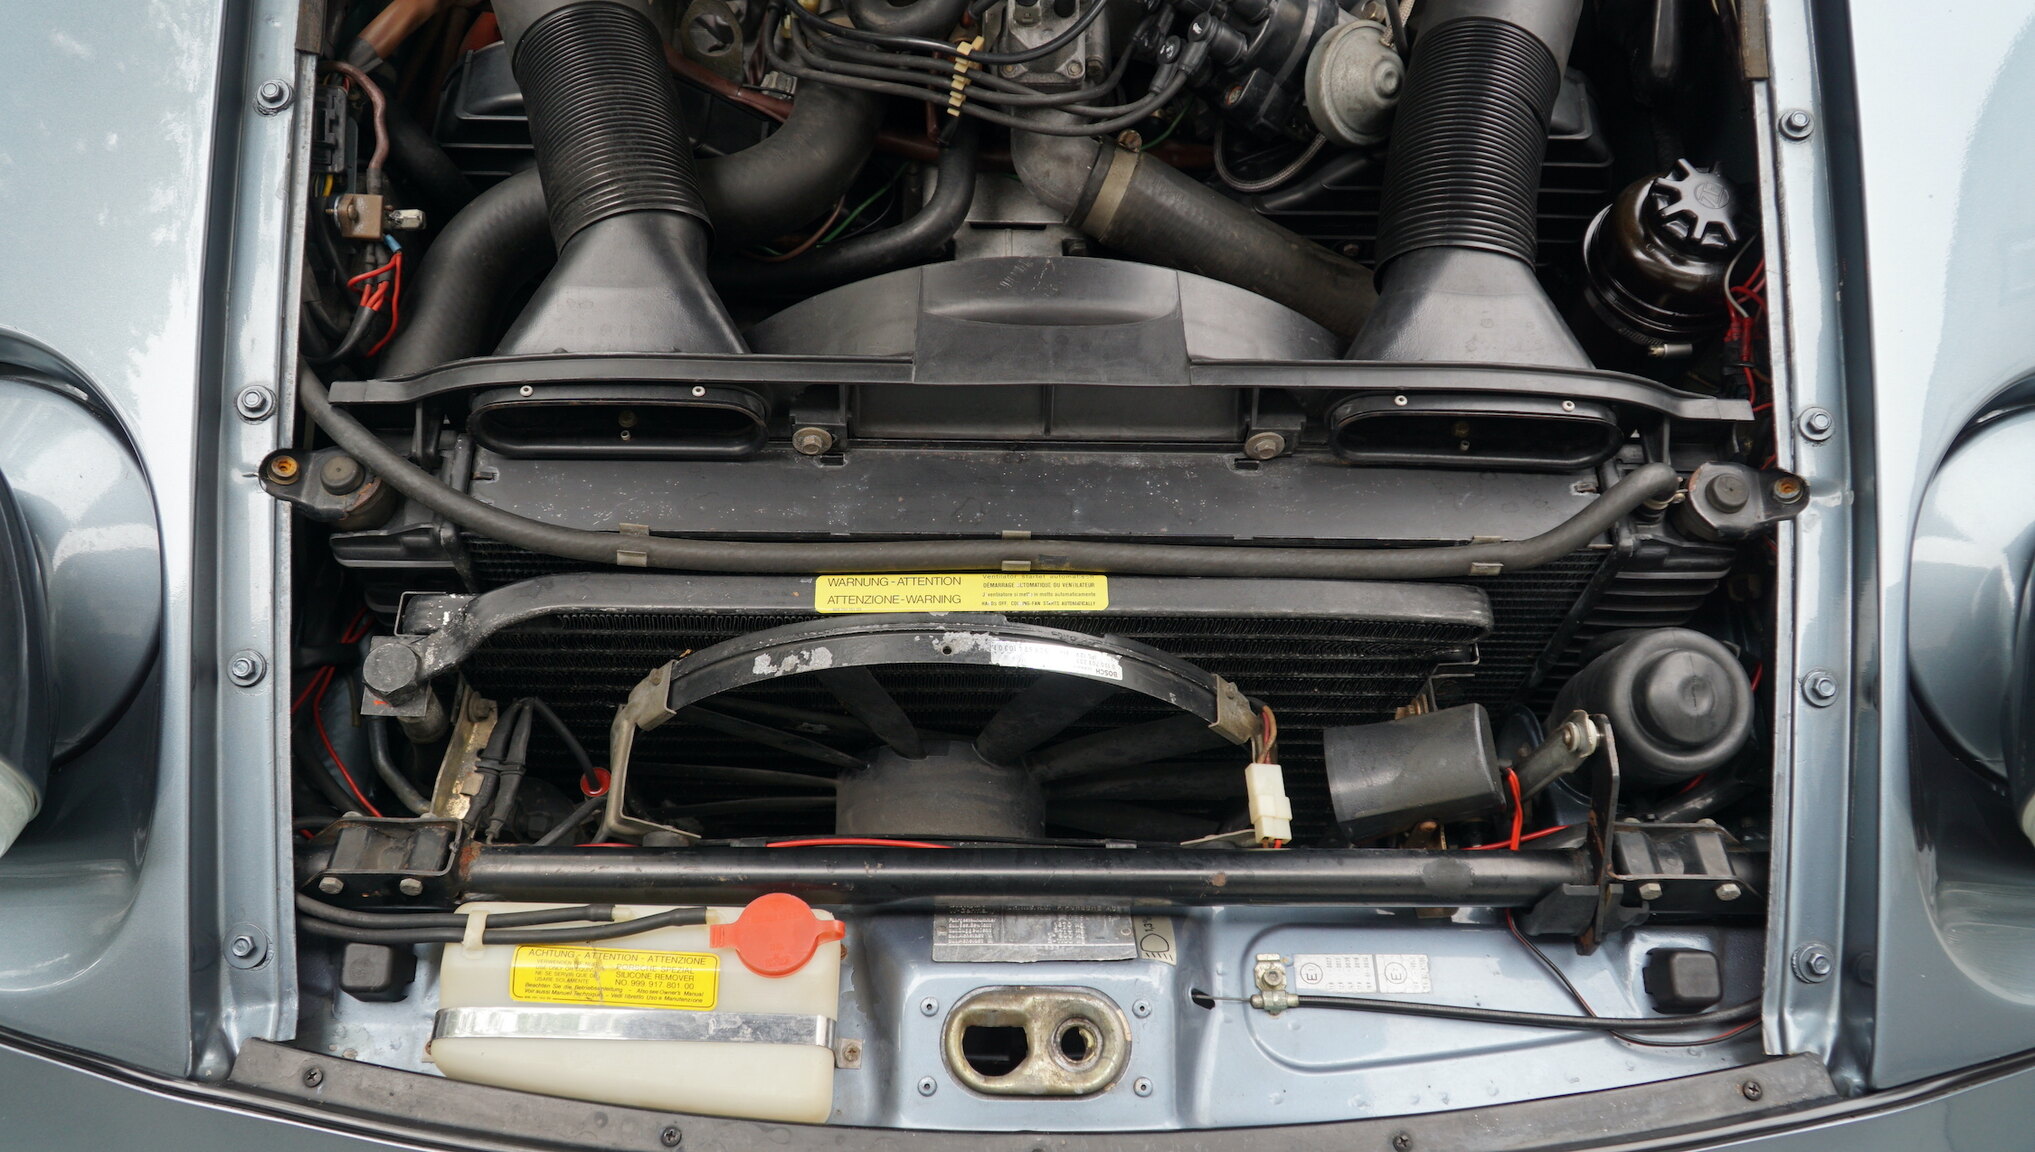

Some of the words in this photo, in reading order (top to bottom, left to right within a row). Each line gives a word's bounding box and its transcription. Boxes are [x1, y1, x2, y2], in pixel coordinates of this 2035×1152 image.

[827, 577, 888, 587] WARNUNG
[897, 576, 962, 586] ATTENTION
[1095, 668, 1118, 678] BOSCH
[528, 948, 575, 958] ACHTUNG
[584, 952, 639, 962] ATTENTION
[647, 955, 706, 965] ATTENZIONE
[616, 963, 656, 972] PORSCHE
[661, 965, 694, 974] SPEZIAL
[616, 971, 652, 979] SILICONE
[654, 973, 695, 982] REMOVER
